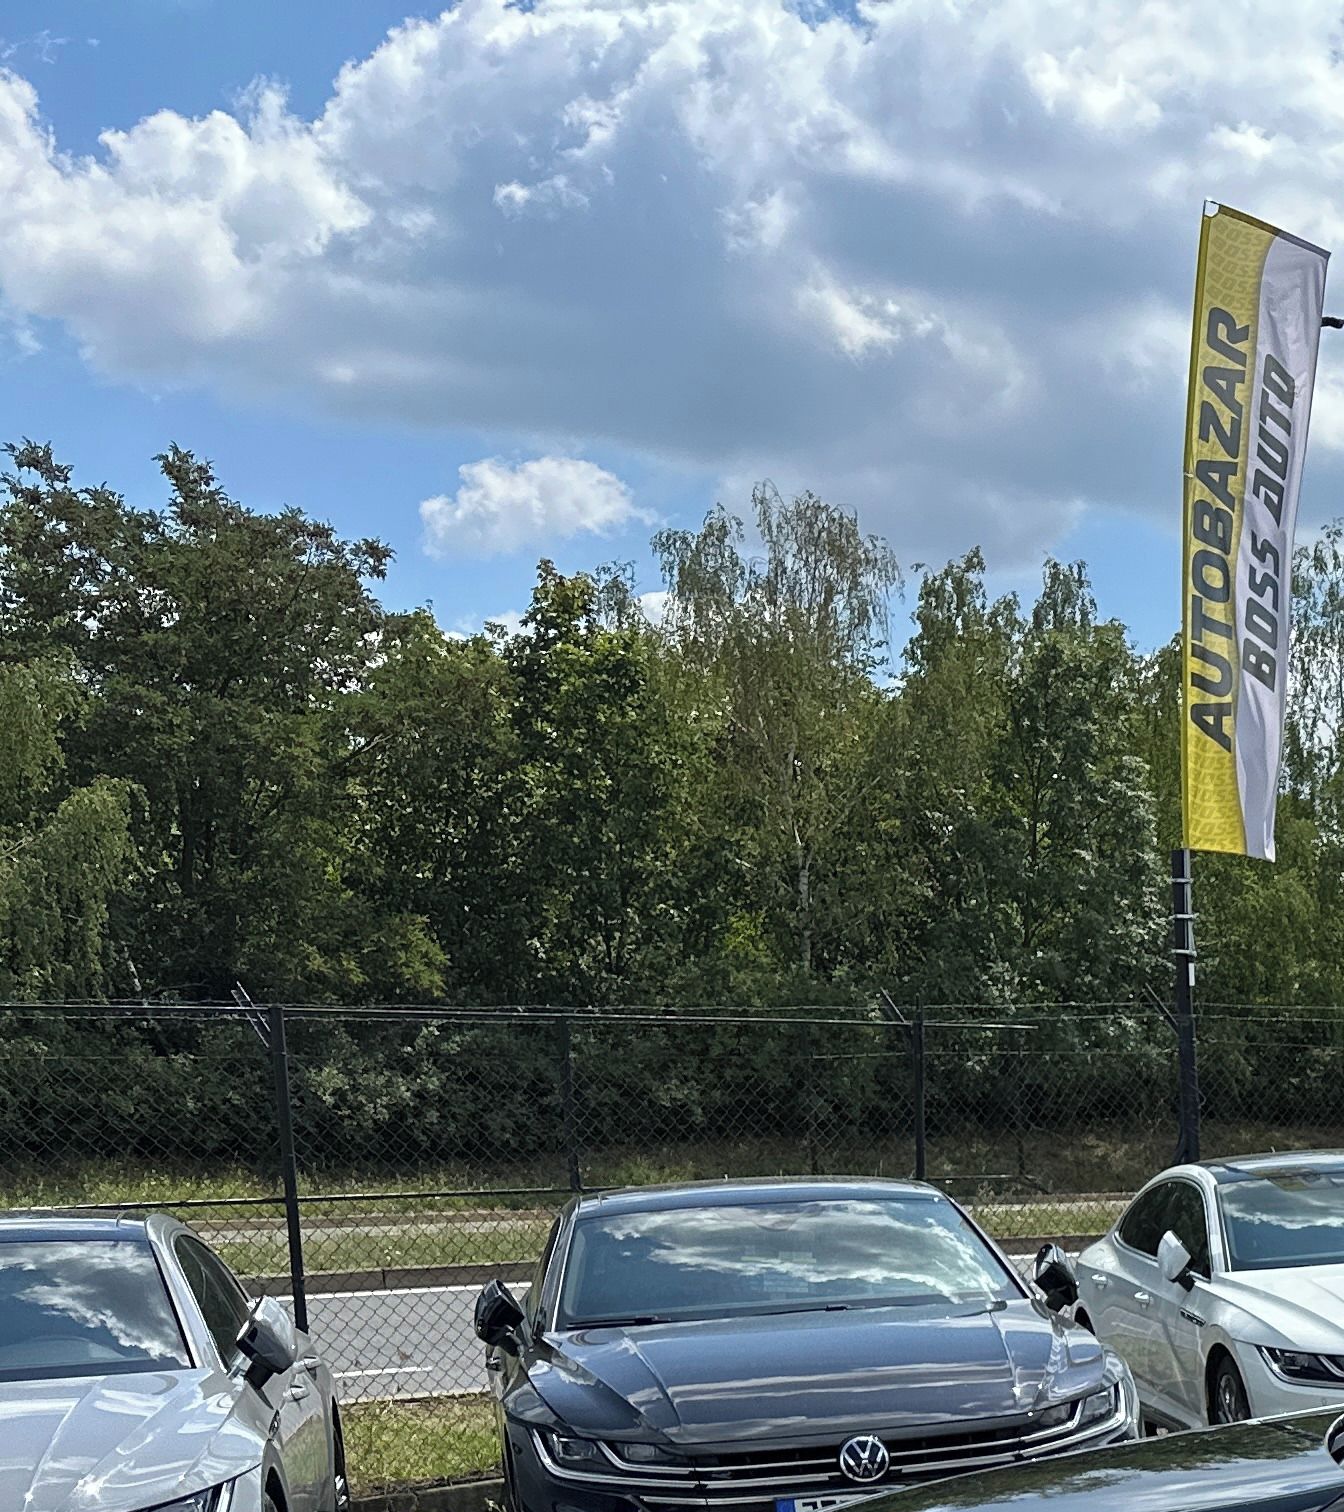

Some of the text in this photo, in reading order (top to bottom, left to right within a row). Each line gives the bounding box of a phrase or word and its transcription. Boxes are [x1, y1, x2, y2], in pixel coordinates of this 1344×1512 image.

[1190, 307, 1249, 753] AUTOBAZAR
[1242, 354, 1295, 693] BOSS AUTO
